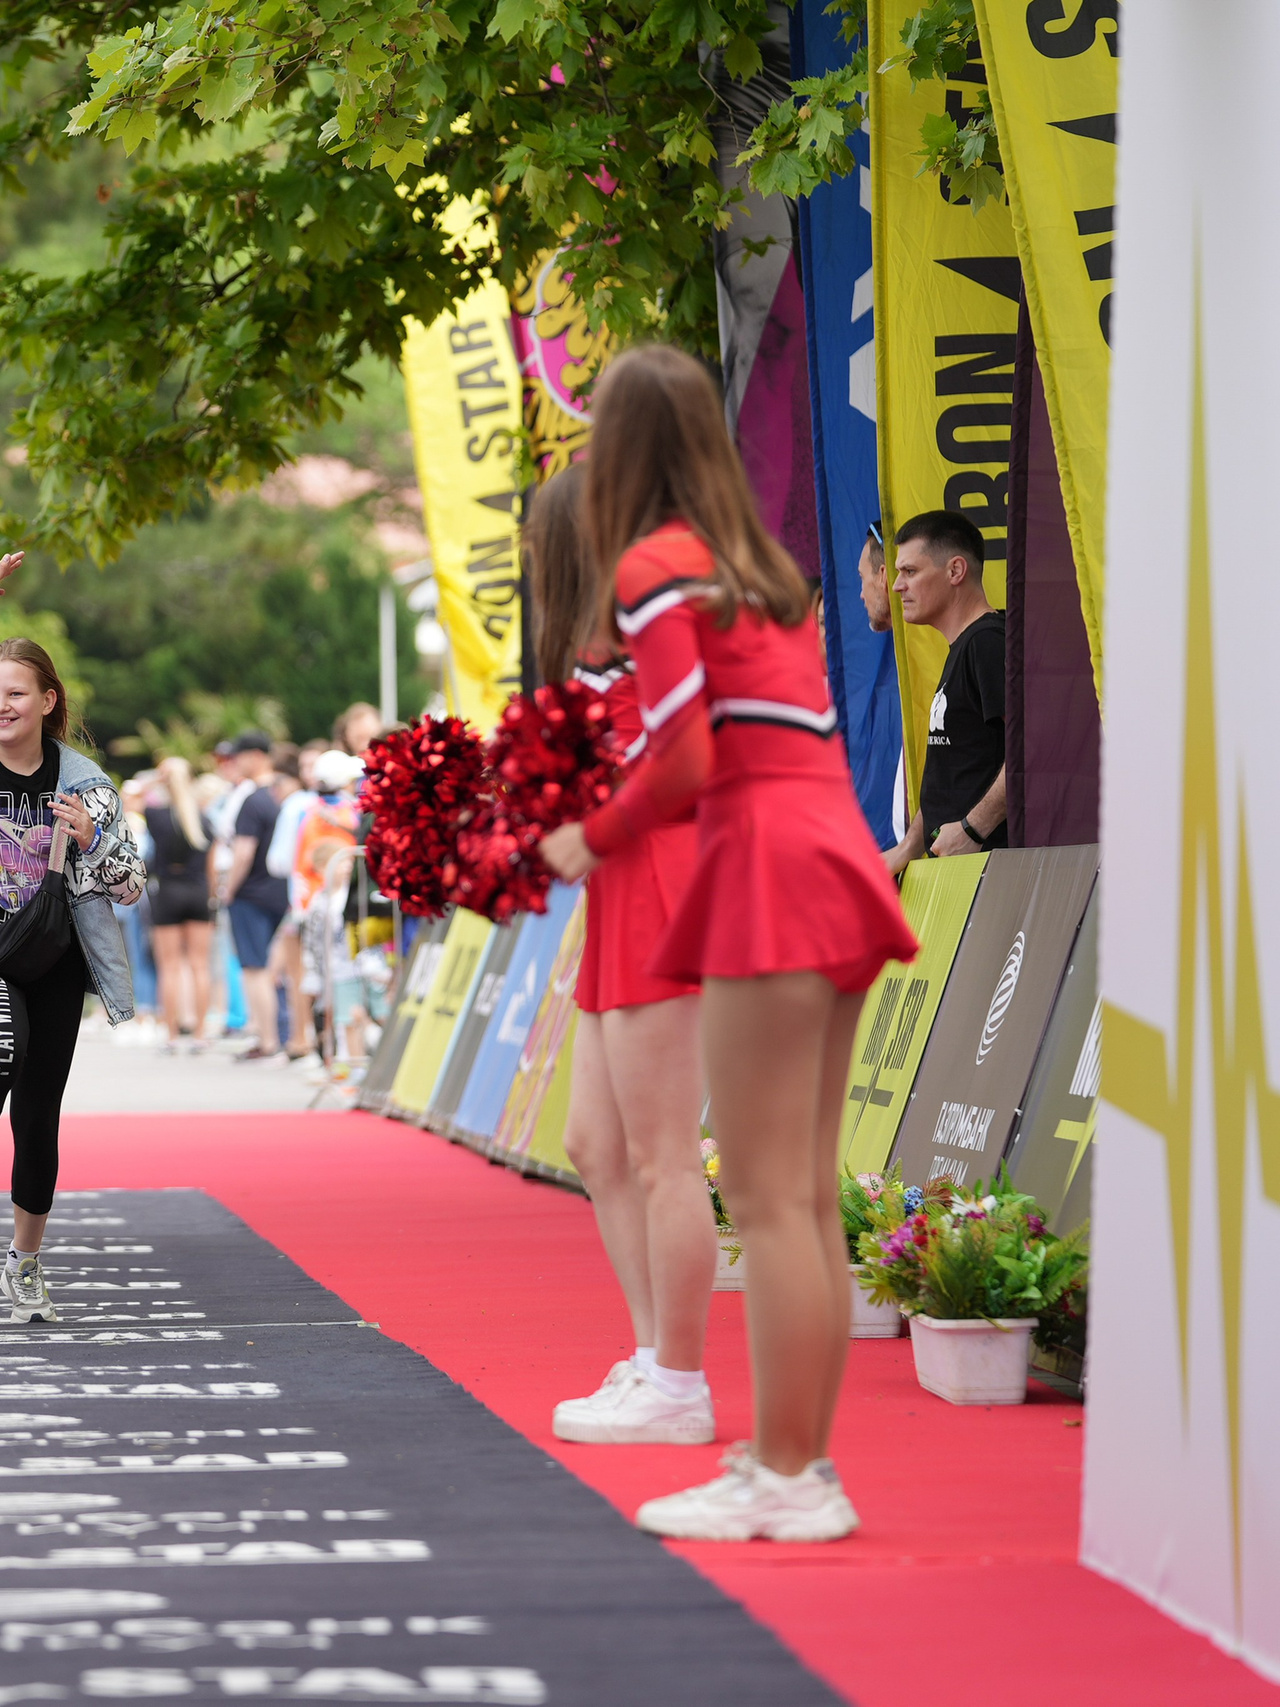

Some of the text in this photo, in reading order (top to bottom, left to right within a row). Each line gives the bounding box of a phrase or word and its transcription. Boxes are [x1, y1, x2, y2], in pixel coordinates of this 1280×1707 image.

[449, 319, 514, 463] STAR
[884, 977, 929, 1070] STAR
[932, 1101, 995, 1151] ГАЗПРОМБАНК
[19, 1451, 348, 1469] STAR
[46, 1539, 430, 1564] STAR
[79, 1665, 548, 1704] STAR
